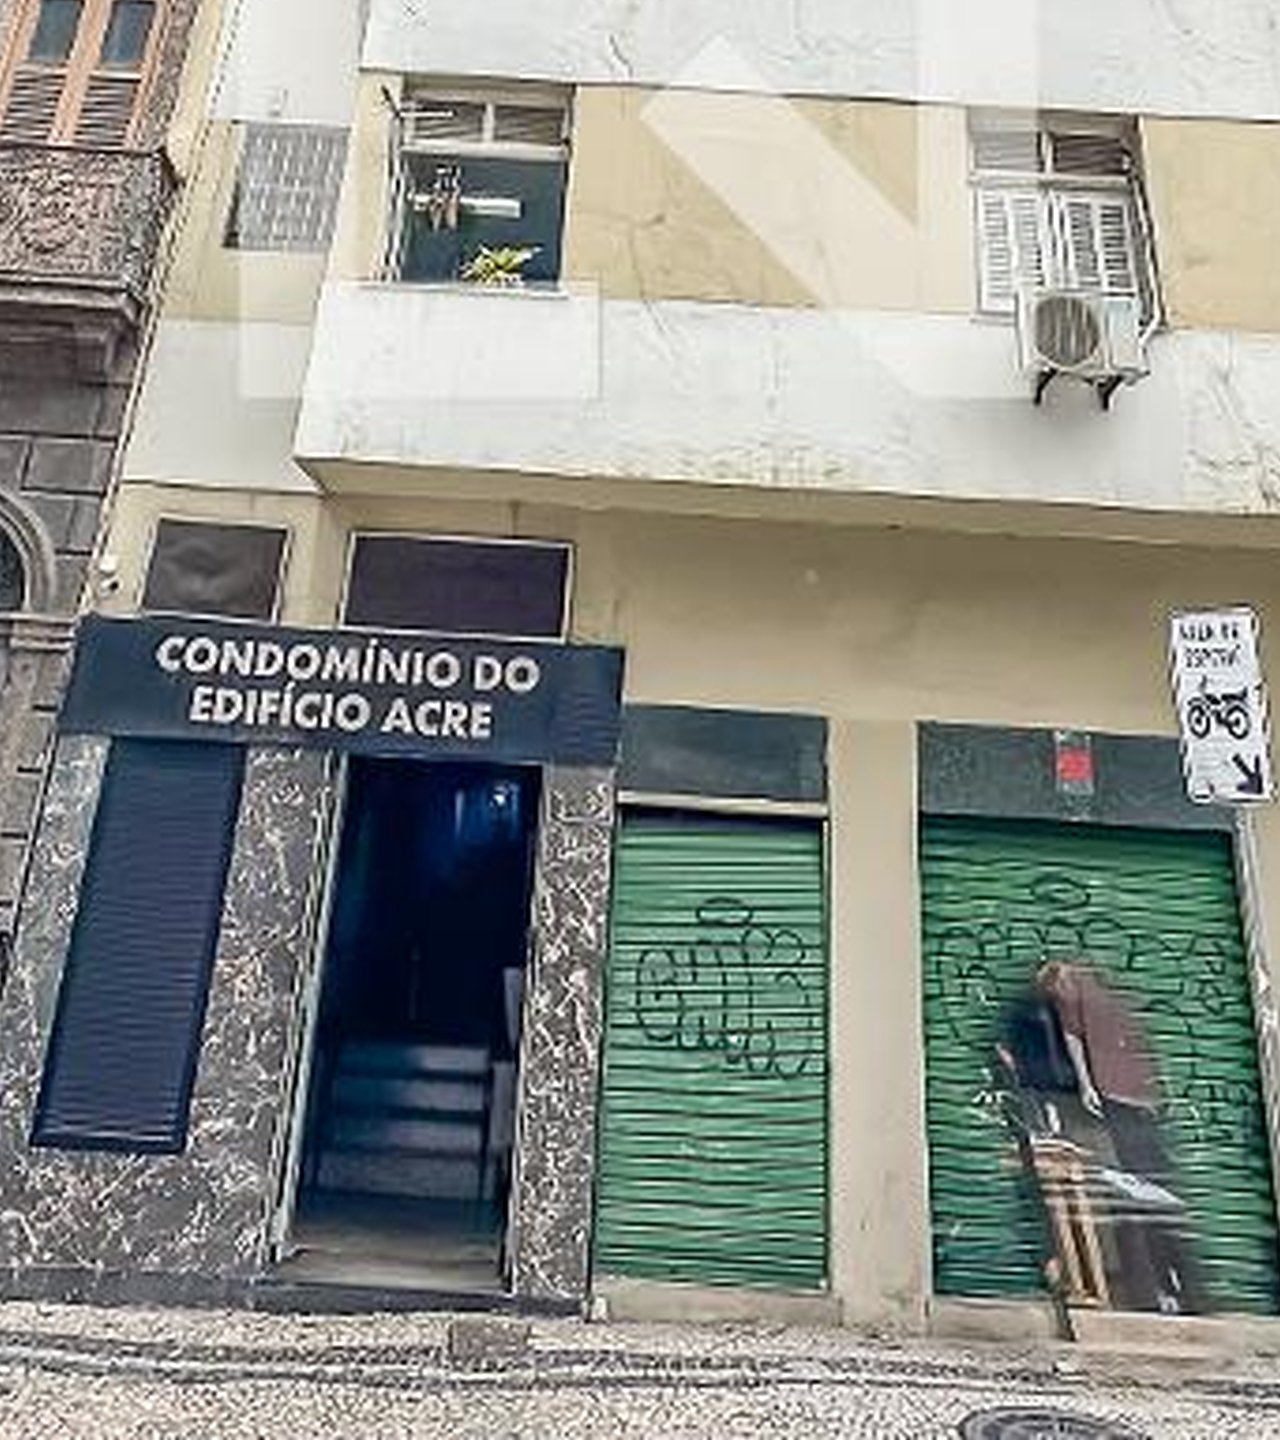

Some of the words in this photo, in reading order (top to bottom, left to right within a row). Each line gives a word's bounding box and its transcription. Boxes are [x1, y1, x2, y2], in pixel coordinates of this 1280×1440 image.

[155, 636, 461, 689] CONDOMÍNIO
[472, 656, 541, 693] DO
[188, 681, 371, 731] EDIFÍCIO
[380, 698, 493, 740] ACRE
